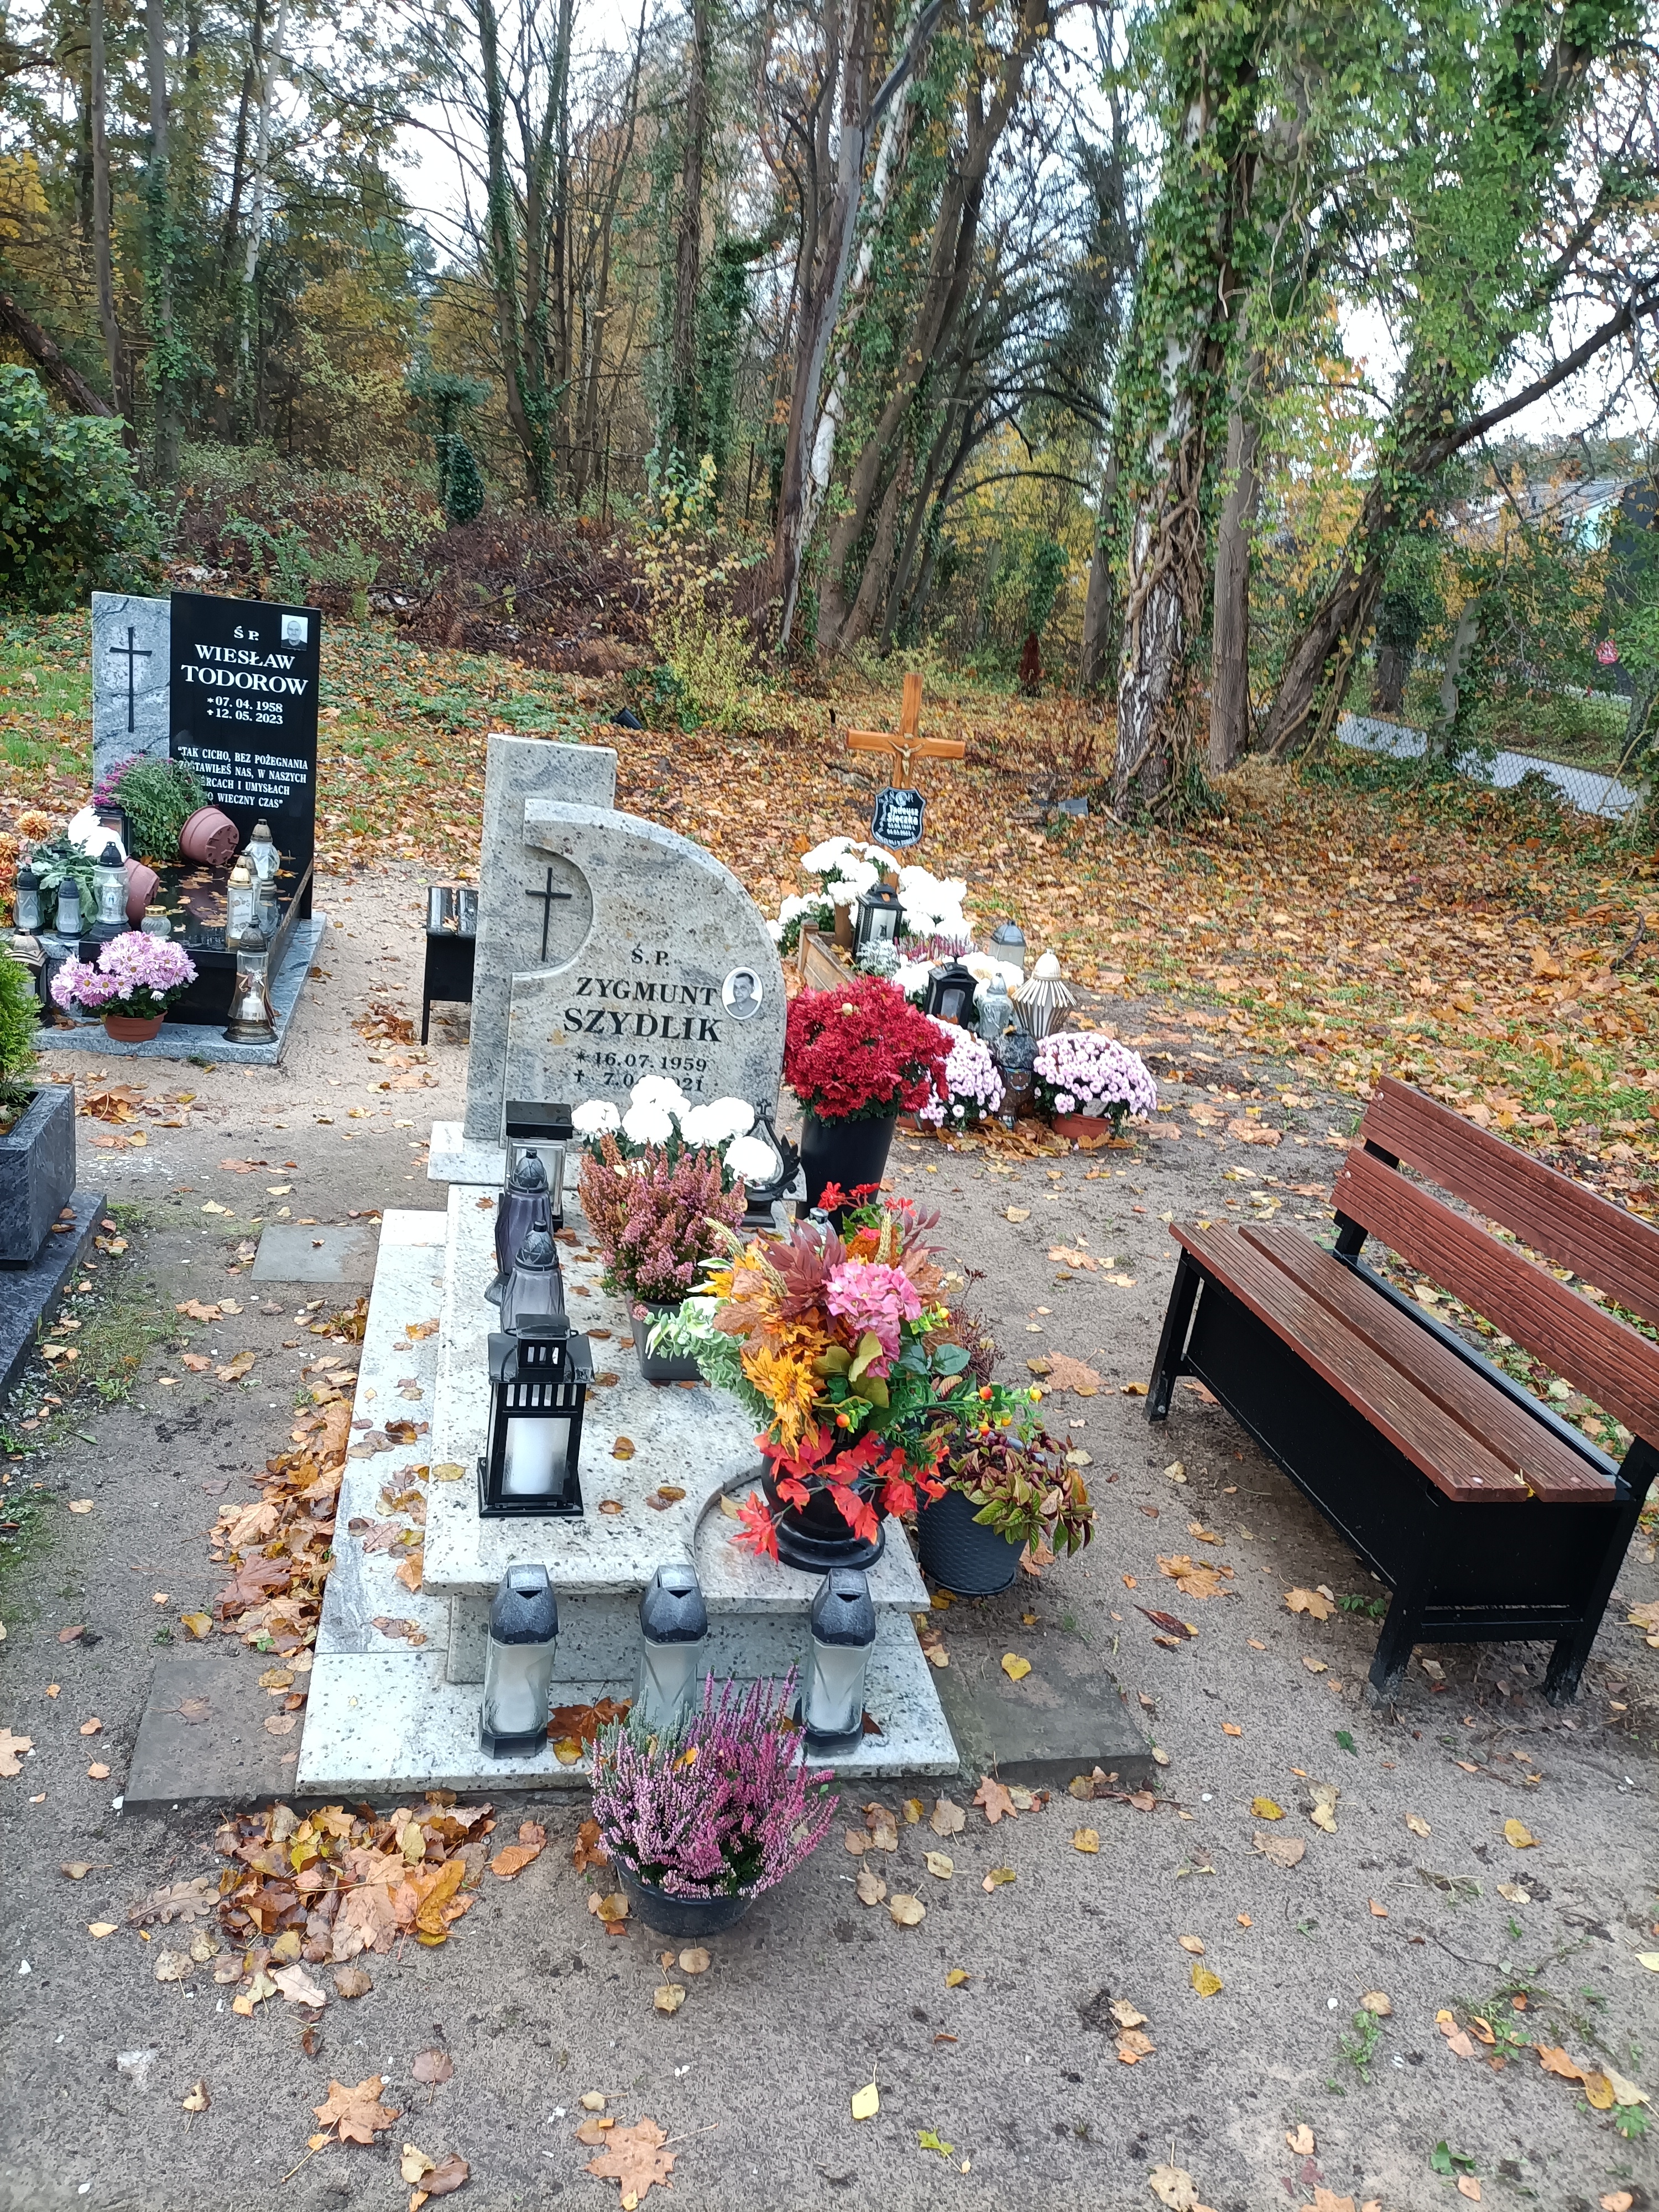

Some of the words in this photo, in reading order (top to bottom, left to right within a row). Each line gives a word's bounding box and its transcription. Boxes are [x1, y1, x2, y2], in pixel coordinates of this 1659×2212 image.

[233, 625, 244, 639] Ś
[248, 630, 259, 641] P.
[195, 644, 295, 670] WIESŁAW
[181, 664, 309, 695] TODOROW
[215, 696, 233, 707] 07.
[236, 698, 253, 709] 04.
[256, 701, 283, 713] 1958
[216, 708, 232, 719] 12.
[235, 710, 253, 721] 05.
[255, 712, 283, 724] 2023
[202, 749, 231, 762] CICHO,
[234, 752, 251, 763] BEZ
[254, 754, 308, 770] POŻEGNANIA
[235, 766, 254, 779] NAS,
[258, 769, 265, 778] W
[269, 770, 306, 783] NASZYCH
[238, 780, 241, 790] I
[245, 781, 290, 795] UMYSŁACH
[217, 792, 255, 805] WIECZNY
[631, 942, 649, 964] Ś.
[656, 950, 670, 966] P.
[576, 977, 718, 1006] ZYGMUNT
[563, 1007, 723, 1042] SZYDLIK
